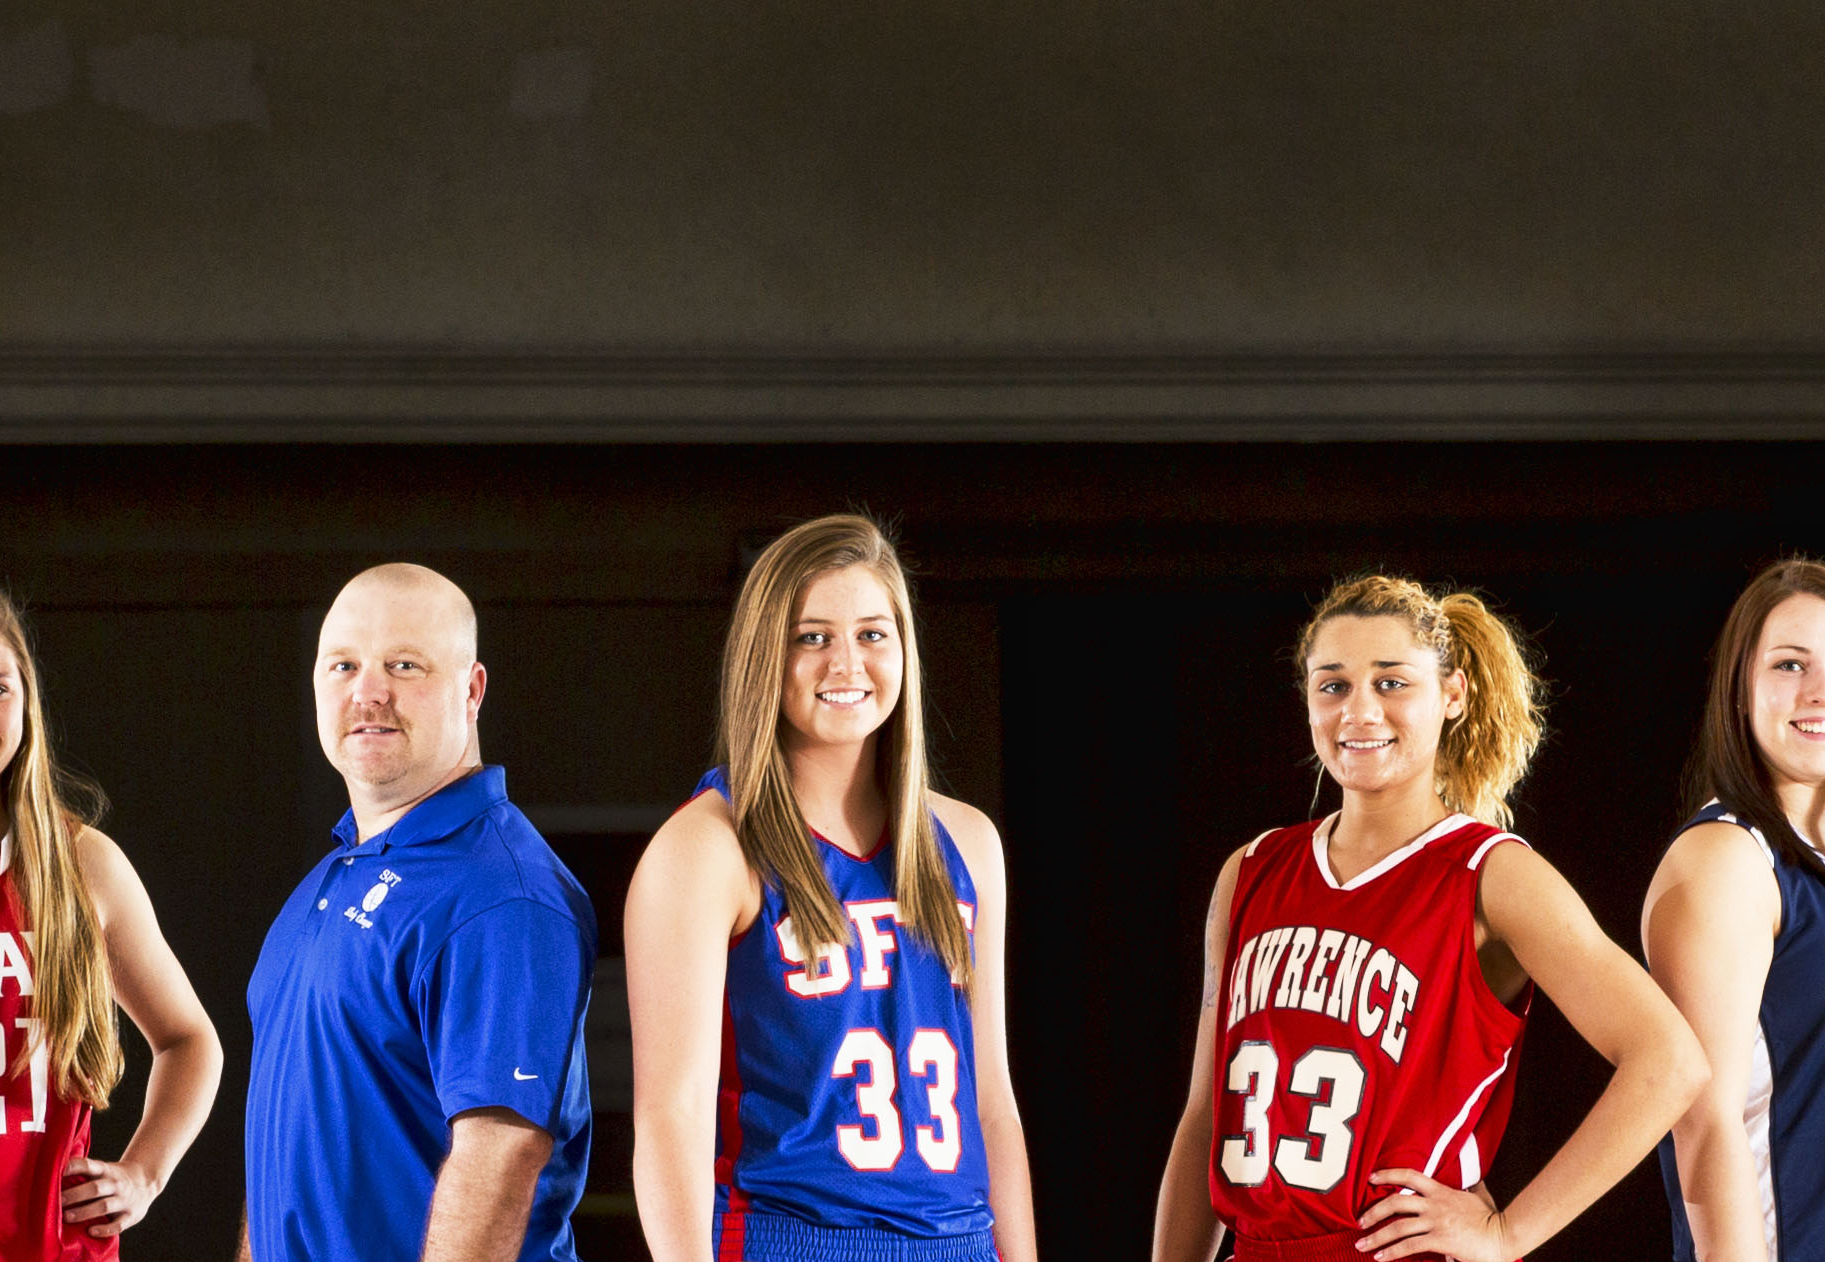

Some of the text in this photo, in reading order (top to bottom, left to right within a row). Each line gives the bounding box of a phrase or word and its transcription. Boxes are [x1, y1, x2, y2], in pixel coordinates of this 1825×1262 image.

[1227, 926, 1421, 1065] AWRENCE
[830, 1027, 962, 1173] 33
[1220, 1040, 1368, 1194] 33
